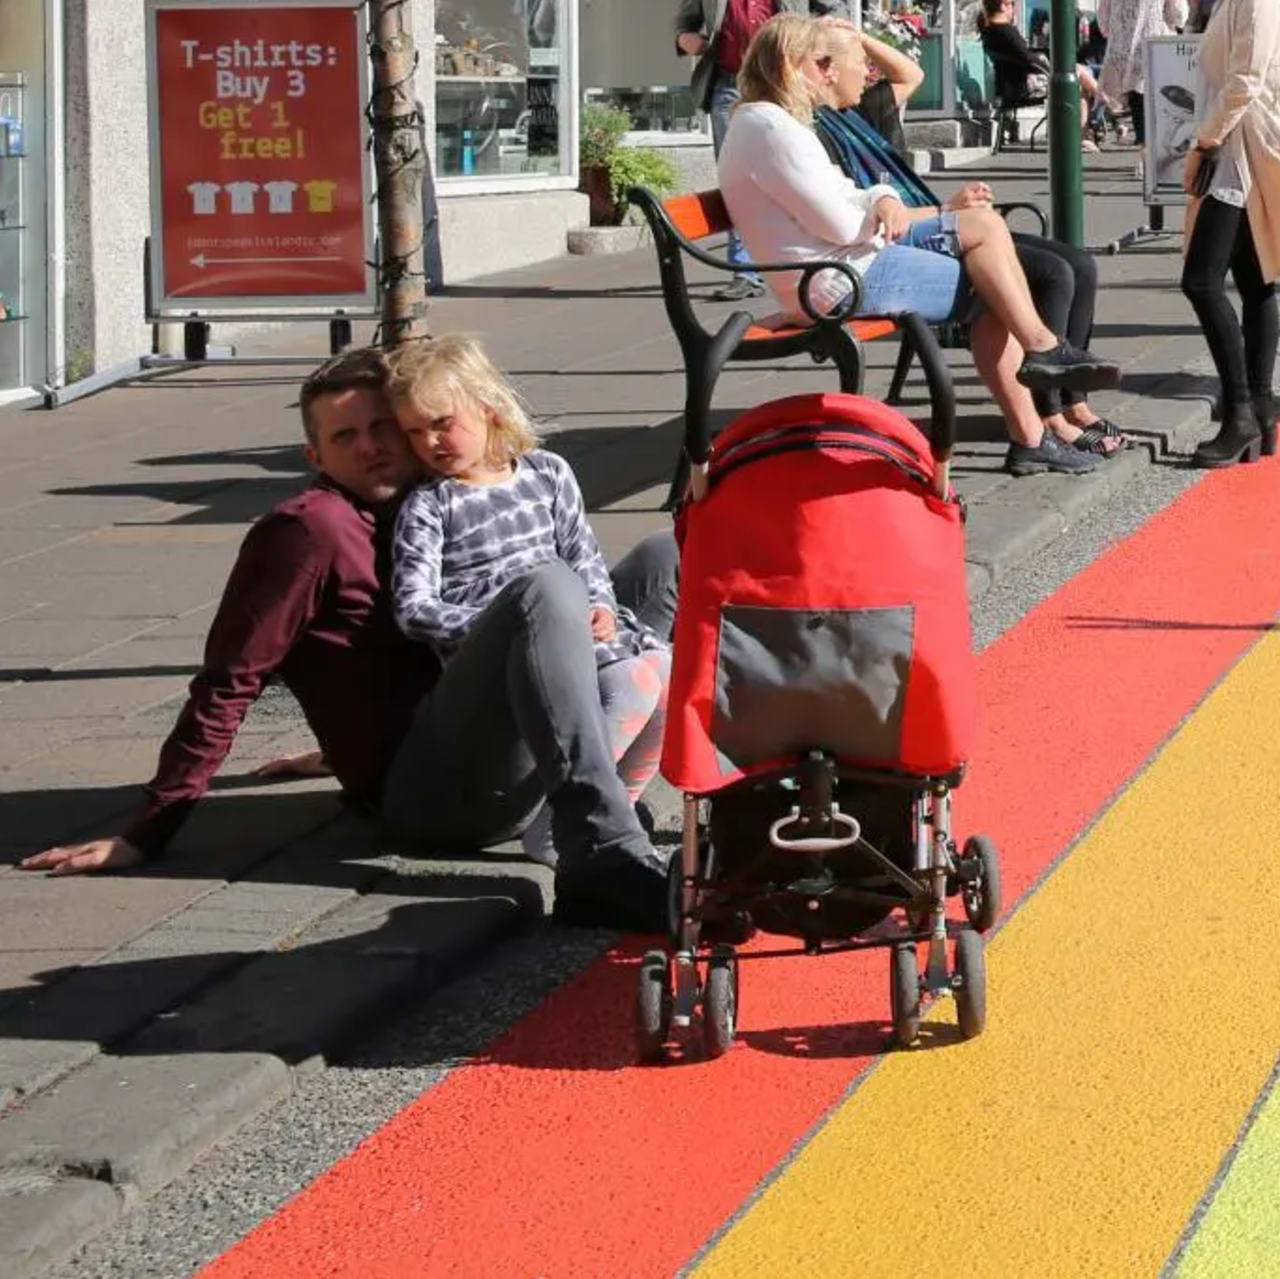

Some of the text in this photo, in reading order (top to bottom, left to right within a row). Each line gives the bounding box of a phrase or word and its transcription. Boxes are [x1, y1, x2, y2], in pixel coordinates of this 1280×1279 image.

[180, 39, 337, 68] T-shirts:
[216, 70, 306, 105] Buy 3
[198, 100, 290, 130] Get 1
[219, 130, 304, 160] free!
